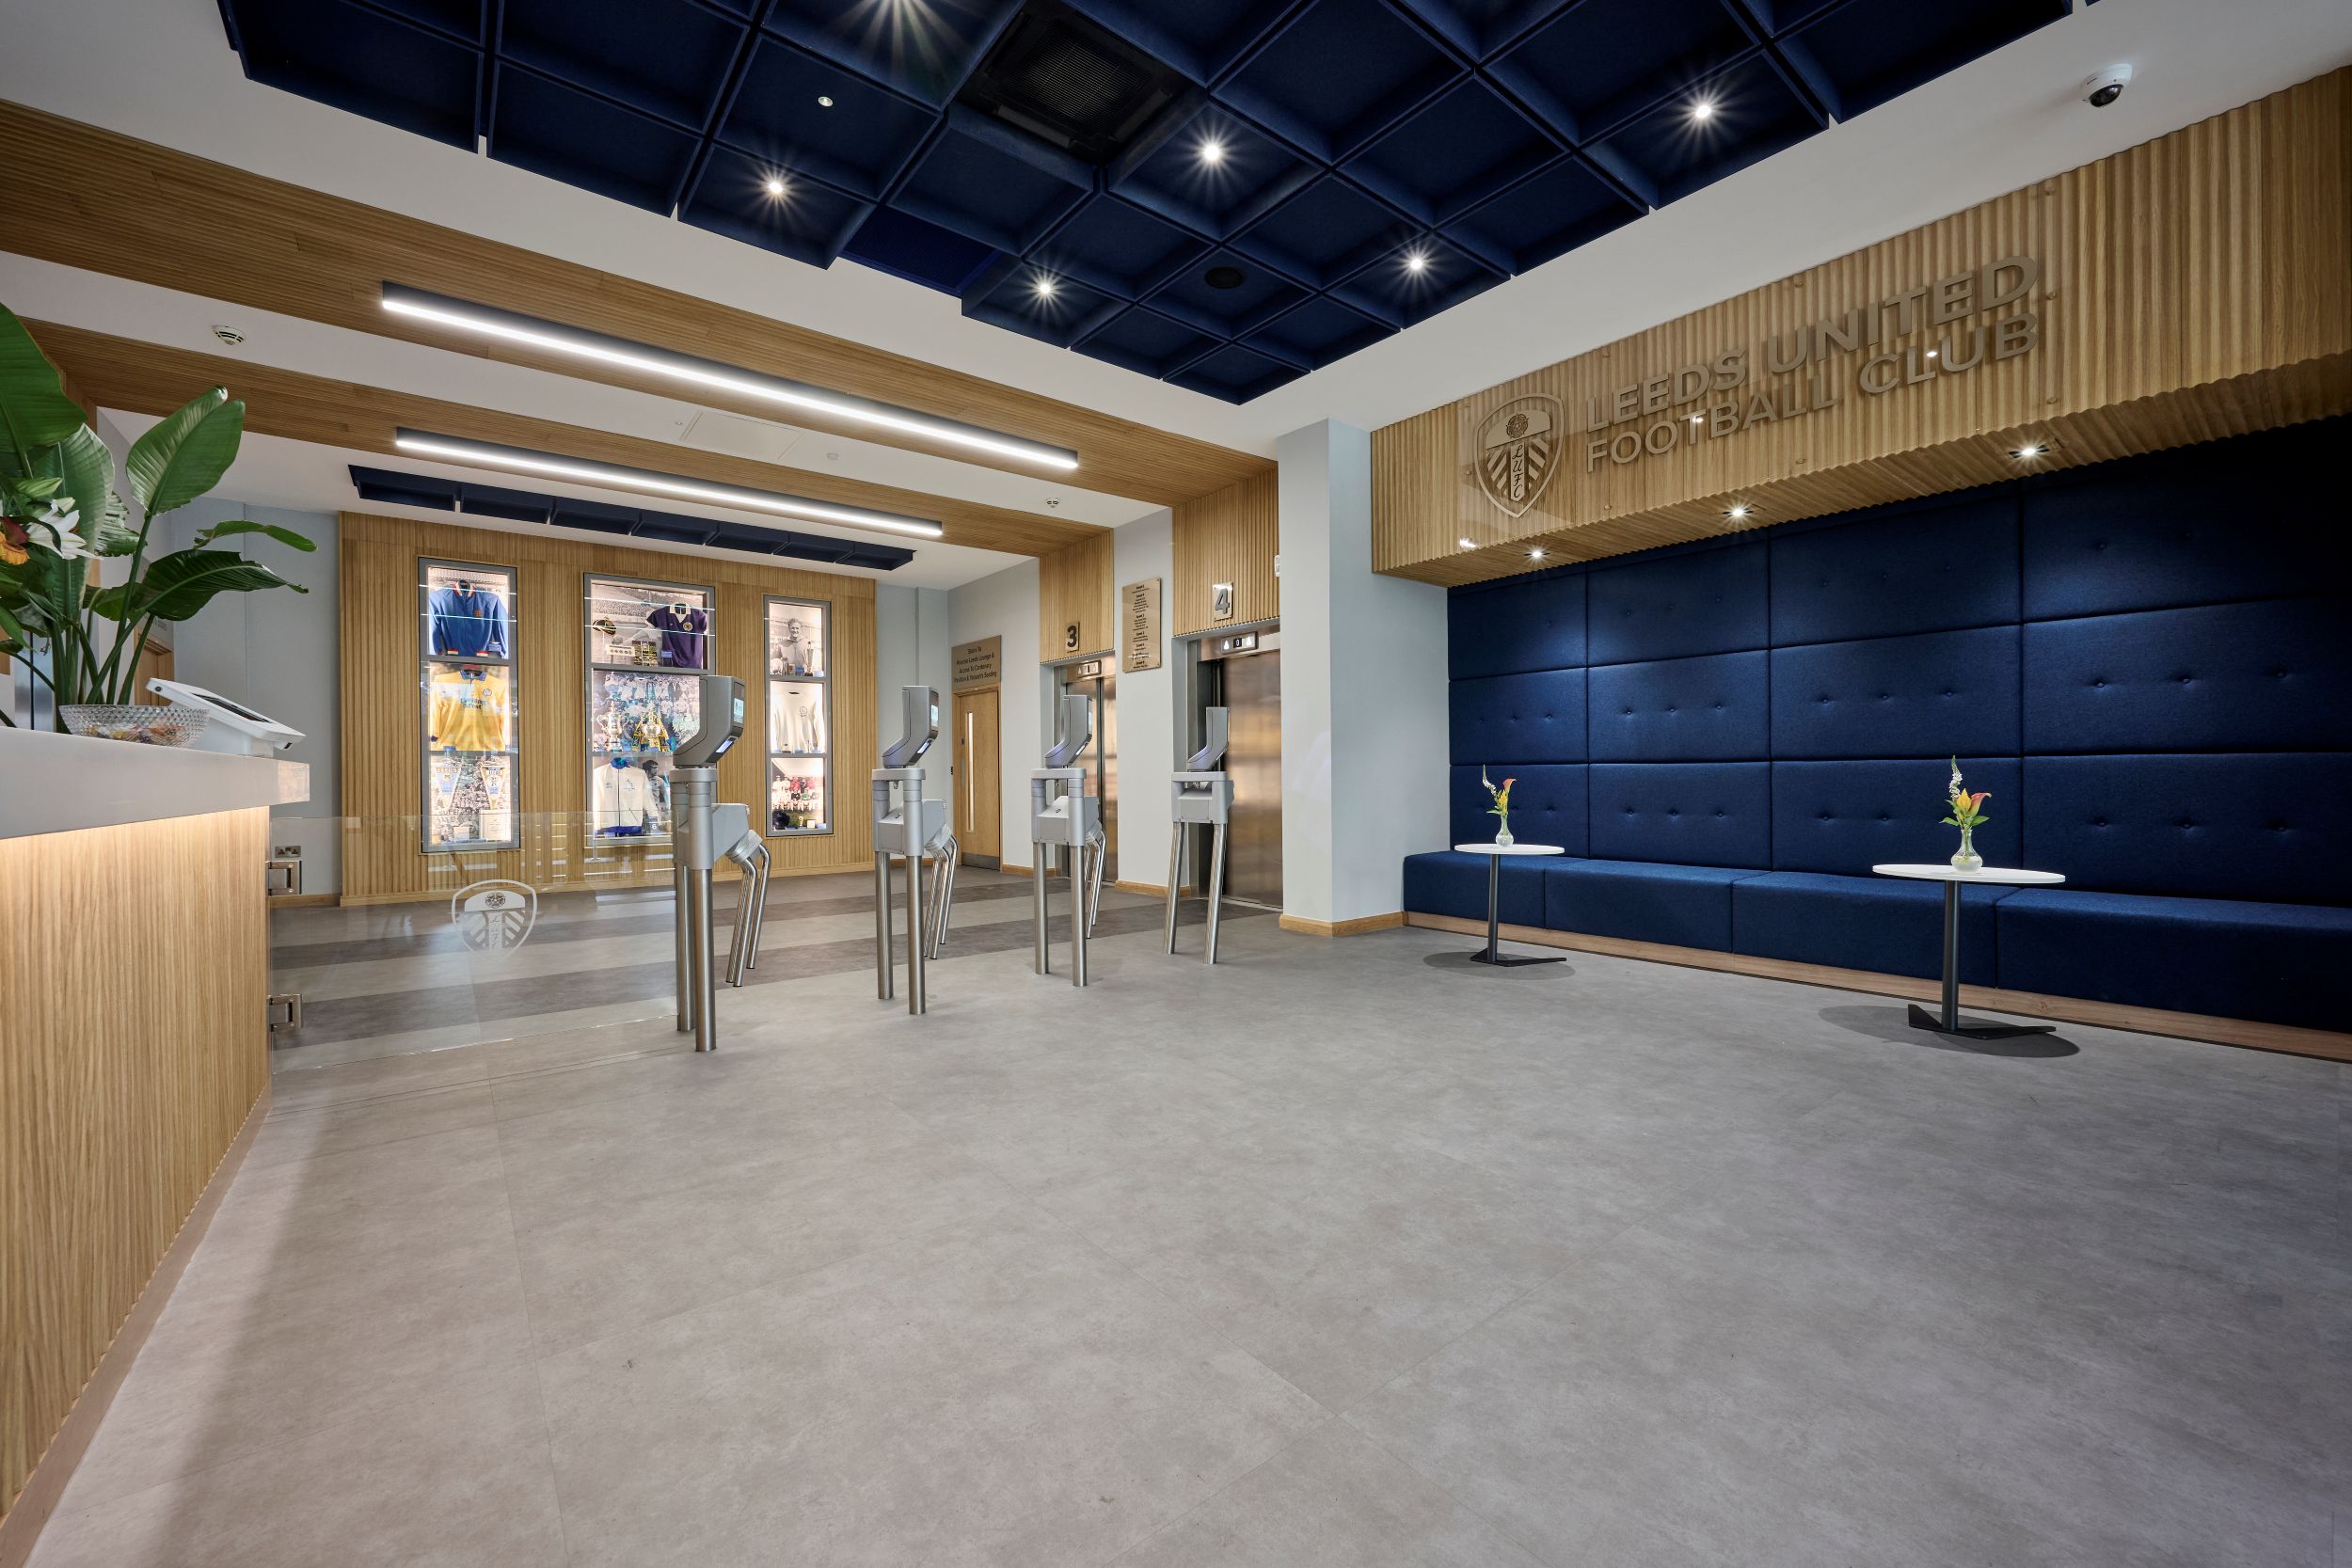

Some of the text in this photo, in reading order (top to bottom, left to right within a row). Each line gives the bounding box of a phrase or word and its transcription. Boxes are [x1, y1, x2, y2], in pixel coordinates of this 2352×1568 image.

[1586, 254, 2040, 433] LEEDS UNITED
[1586, 311, 2040, 472] FOOTBALL CLUB
[1512, 444, 1523, 499] LUFC
[1215, 588, 1230, 614] 4
[1067, 625, 1077, 648] 3
